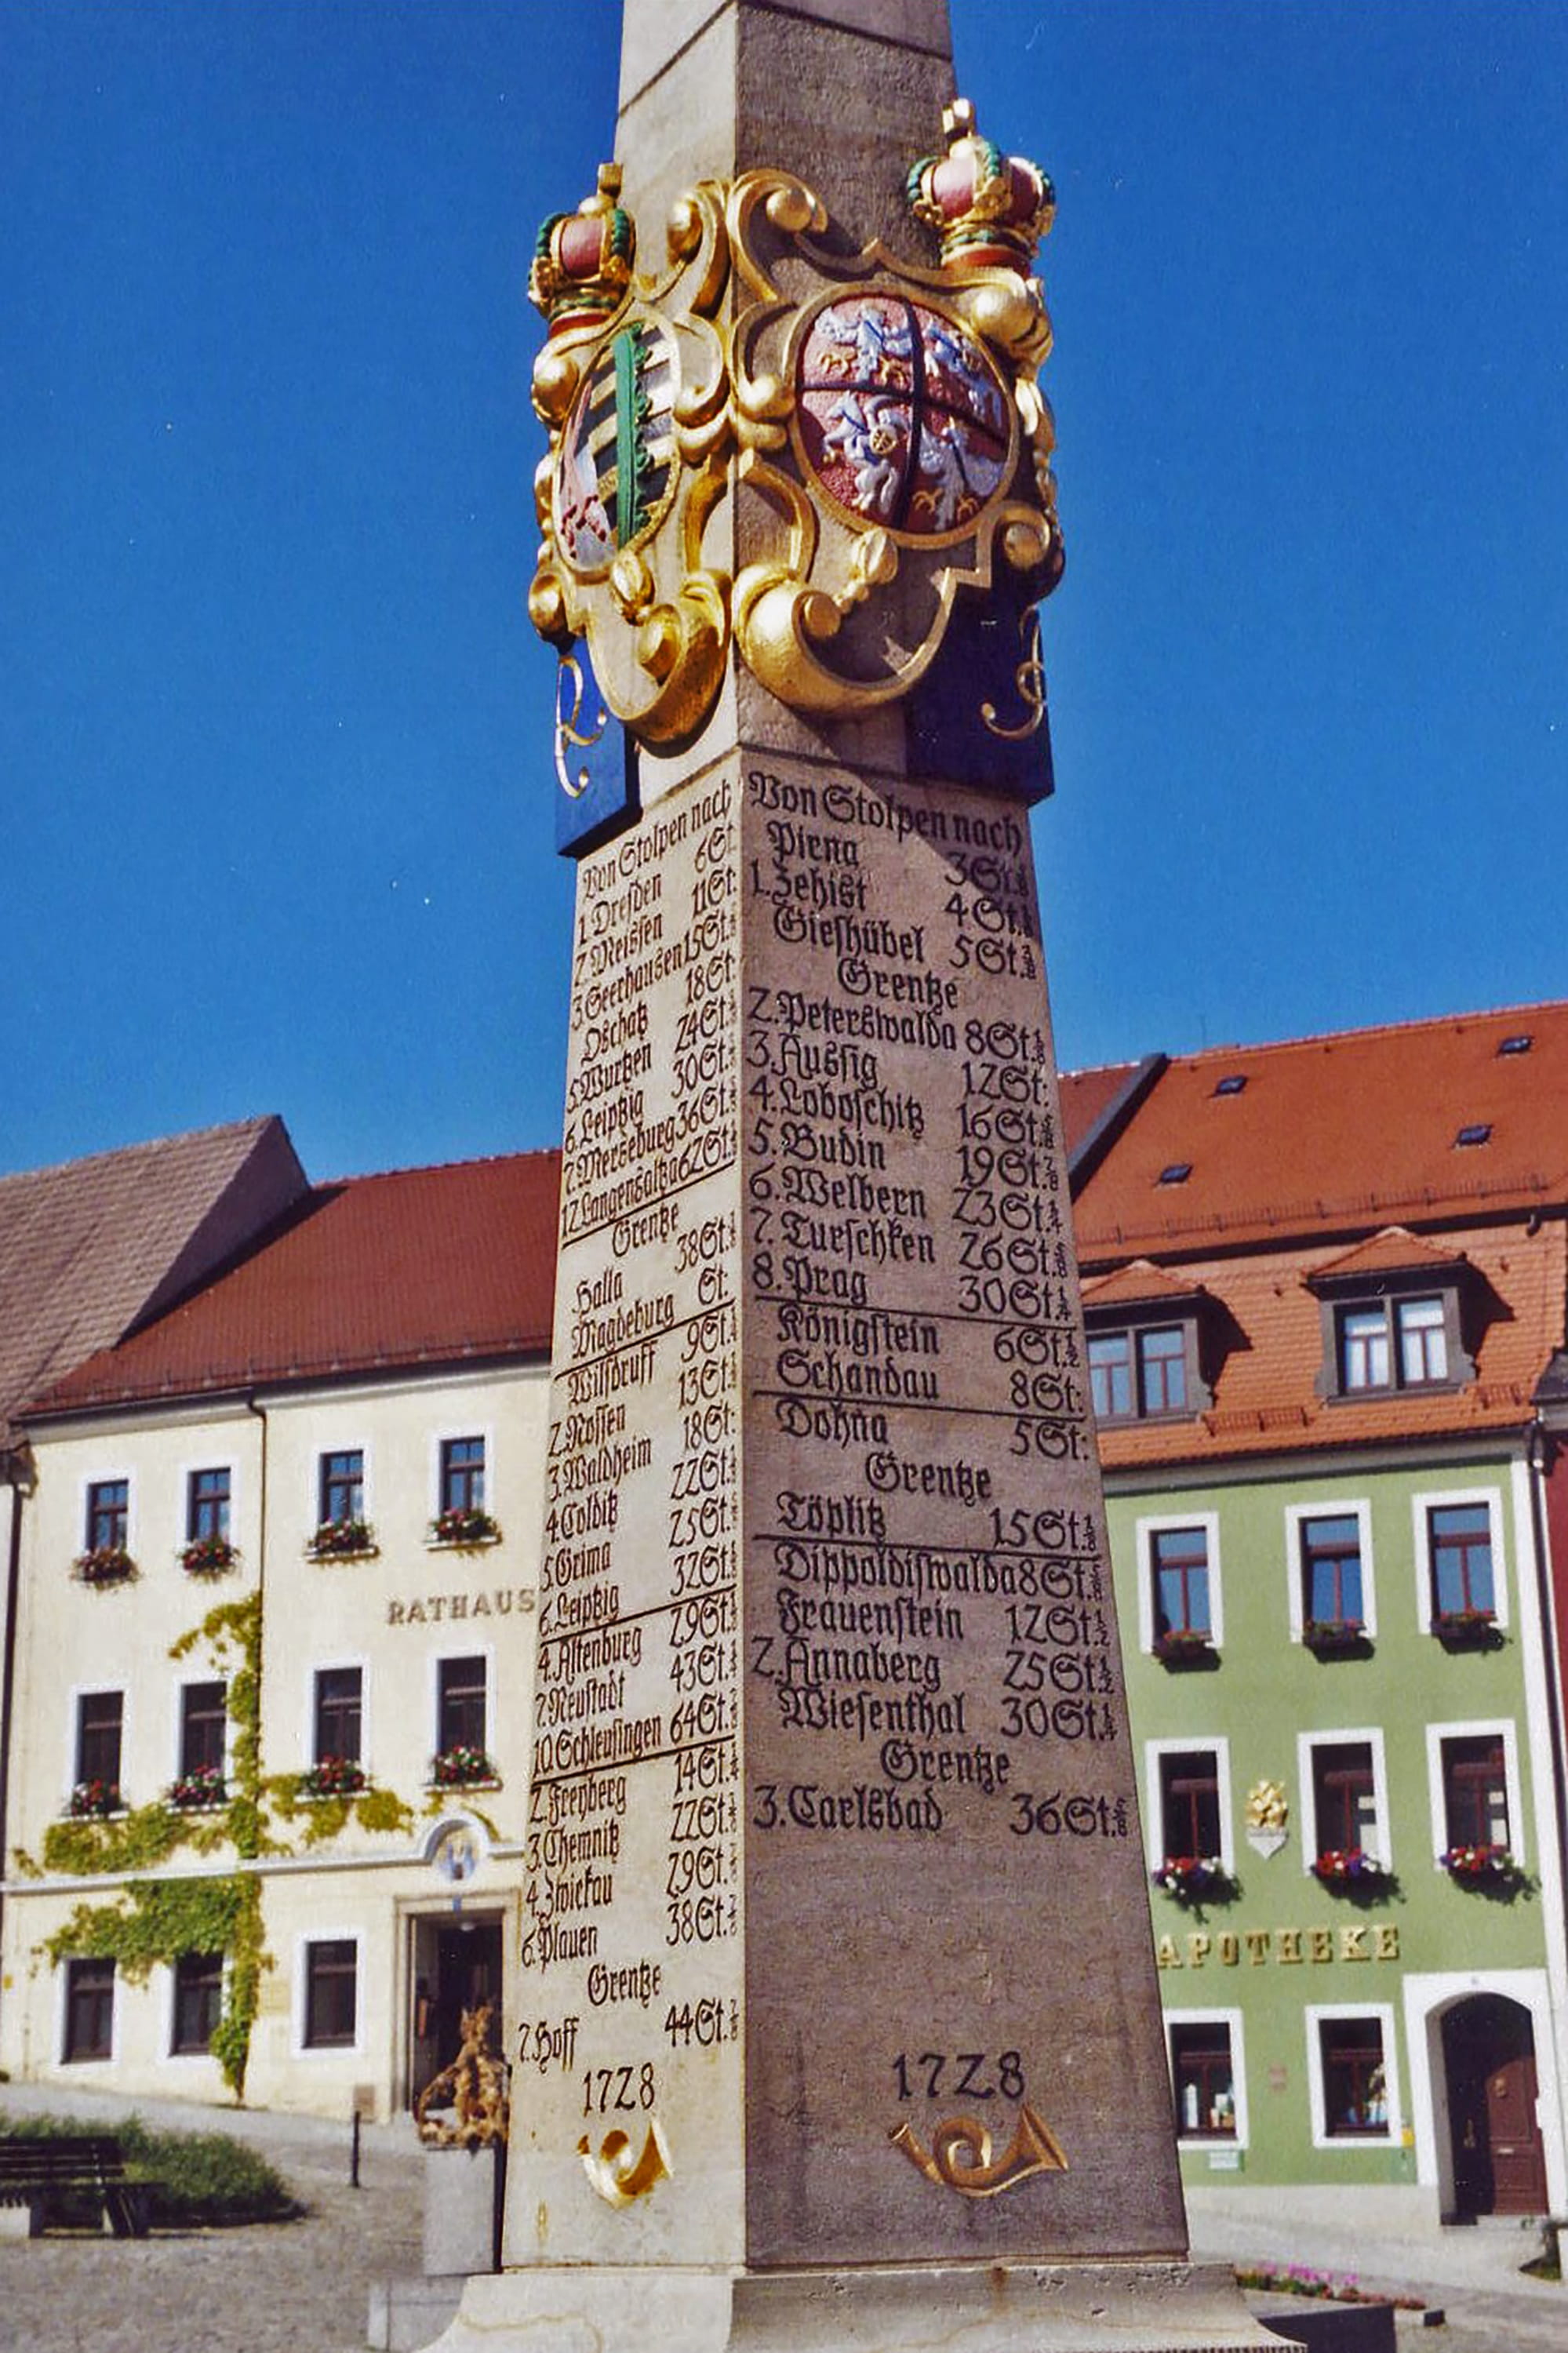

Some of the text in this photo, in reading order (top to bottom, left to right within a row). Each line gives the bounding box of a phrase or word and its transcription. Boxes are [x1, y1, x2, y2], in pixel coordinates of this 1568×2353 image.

[388, 1588, 535, 1626] RATHAUS
[1158, 1924, 1399, 1969] APOTHEKE
[583, 2062, 656, 2117] 1728
[893, 2050, 1024, 2100] 1728
